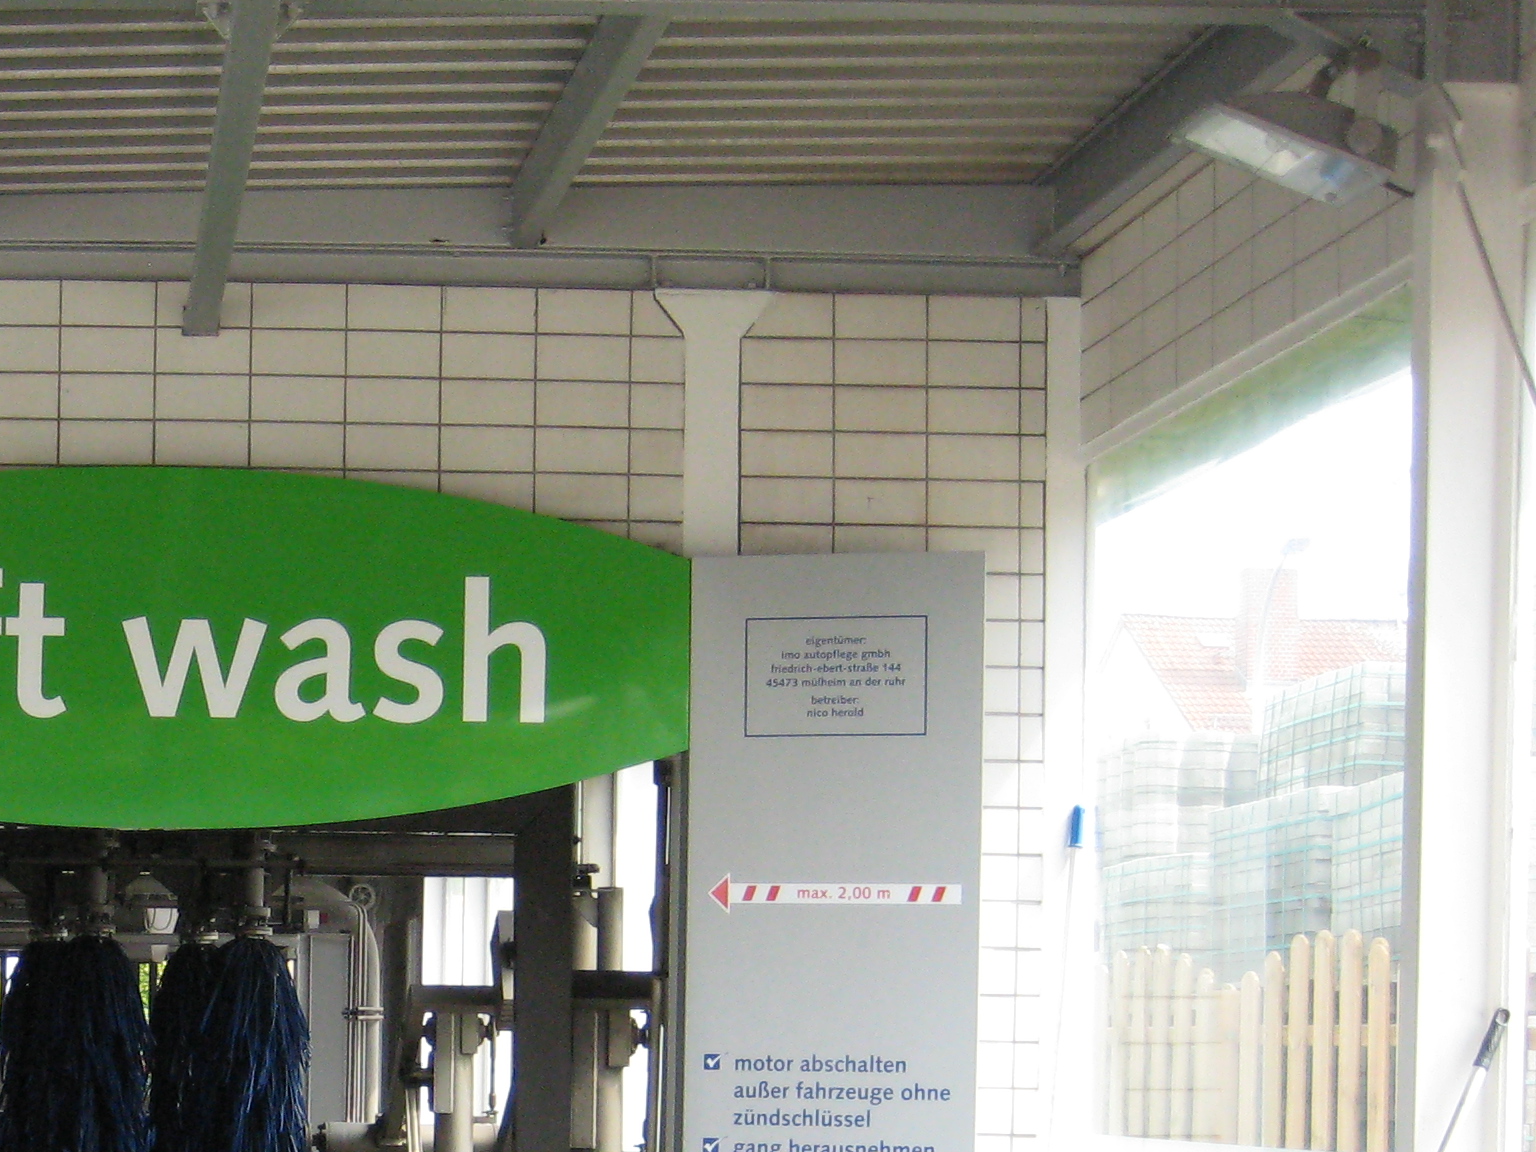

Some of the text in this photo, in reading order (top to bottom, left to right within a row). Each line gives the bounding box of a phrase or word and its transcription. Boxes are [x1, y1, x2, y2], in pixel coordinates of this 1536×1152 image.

[805, 635, 867, 648] eigentümer:
[122, 576, 548, 724] wash
[781, 649, 891, 663] imo autopflege gmbh
[770, 662, 902, 675] friedrich-ebert-straße 144
[765, 676, 907, 689] 45473 mülheim an der ruhr
[810, 695, 860, 706] betreiber:
[806, 707, 865, 719] nico herold
[797, 886, 891, 902] max. 2,00 m
[734, 1054, 907, 1074] motor abschalten
[733, 1081, 952, 1106] außer fahrzeuge ohne
[733, 1109, 872, 1128] zündschlüssel
